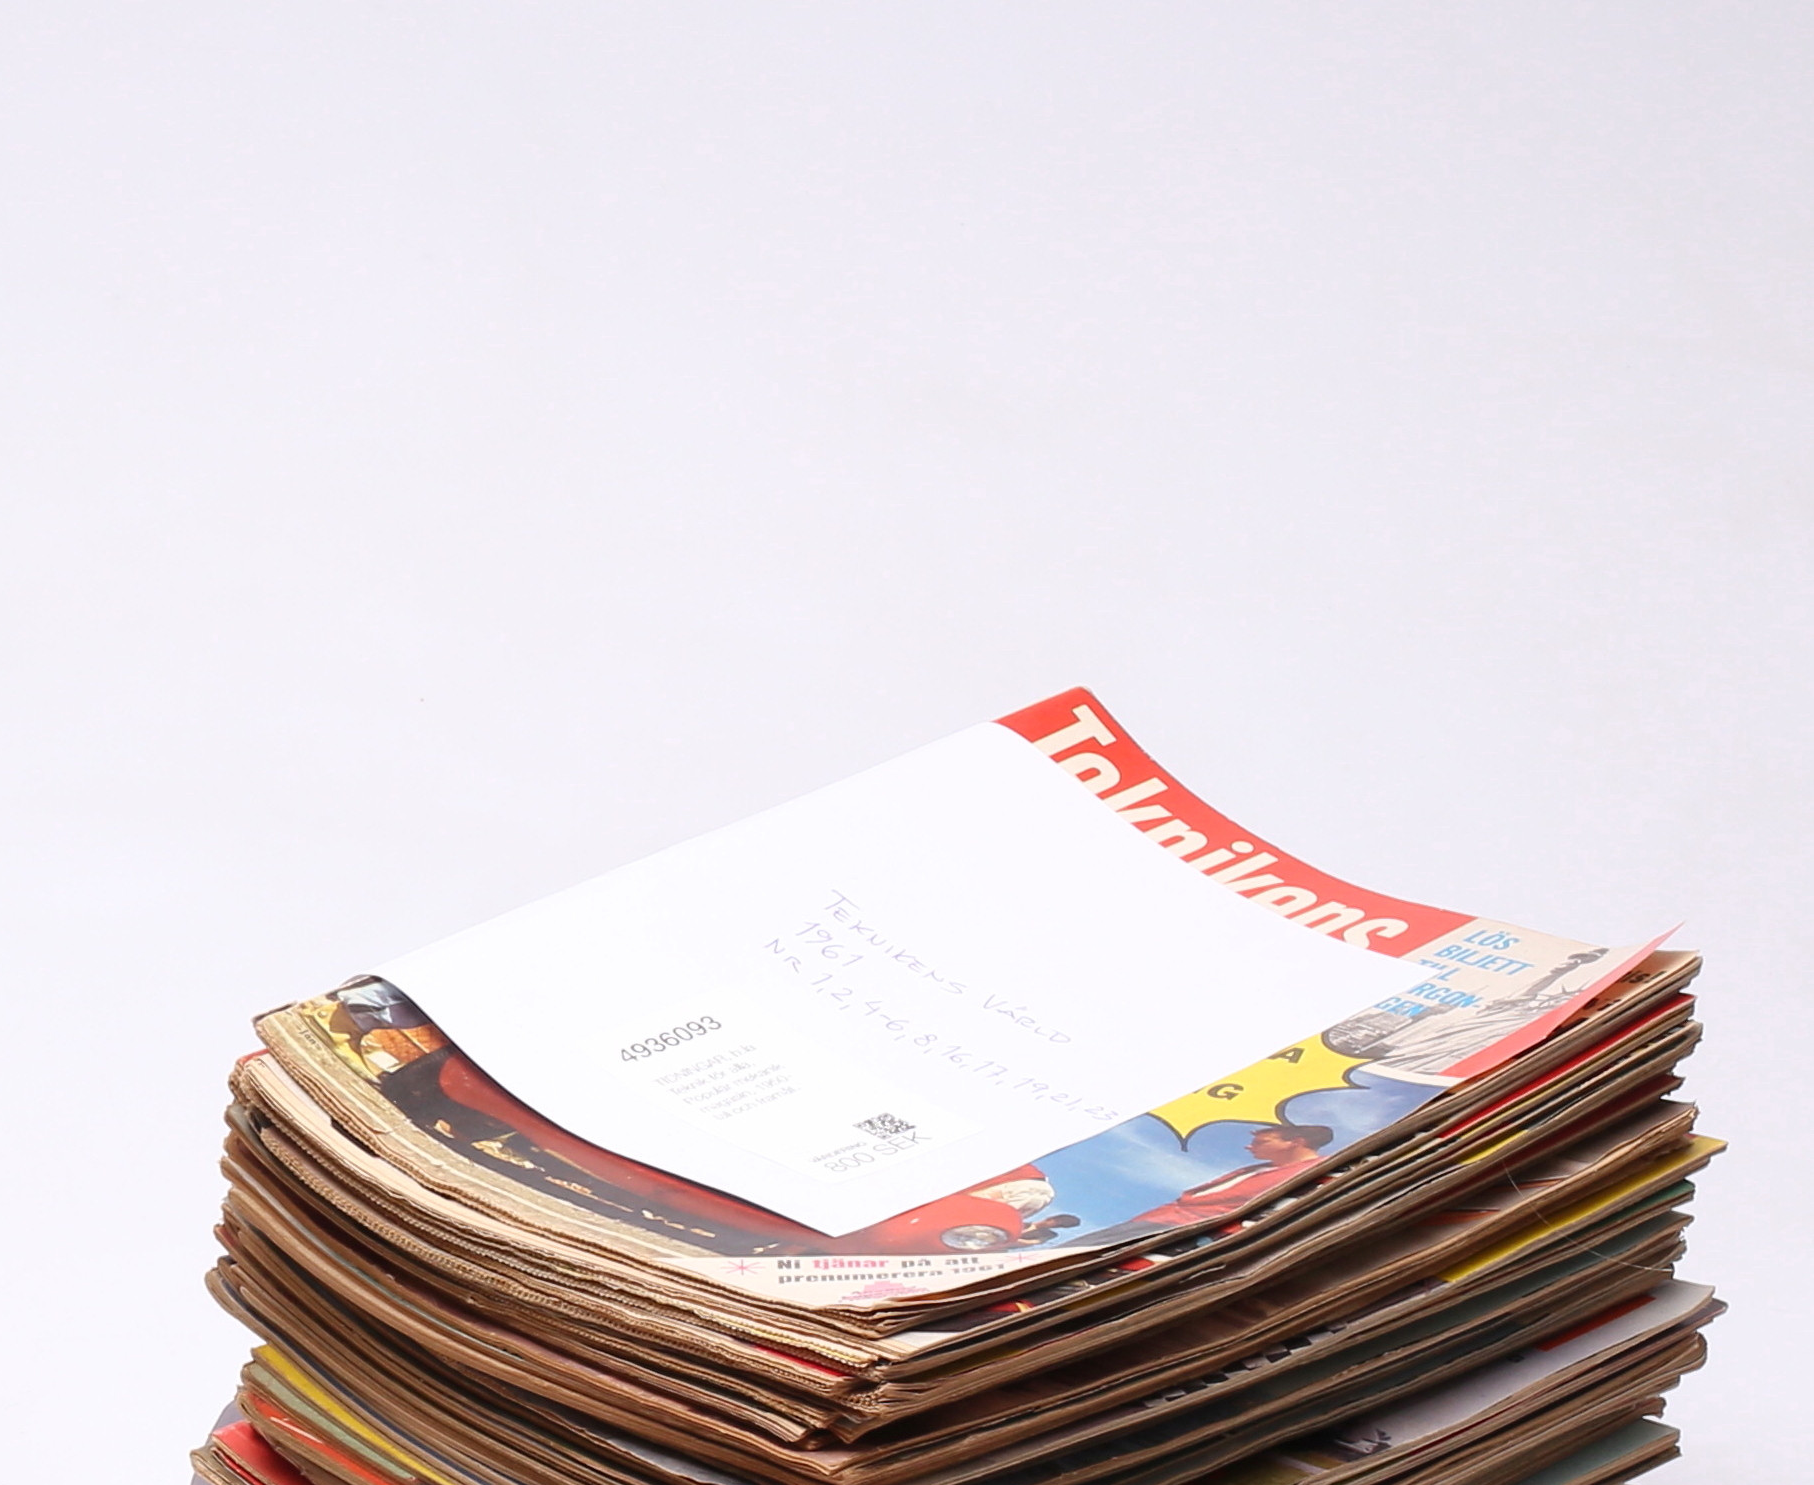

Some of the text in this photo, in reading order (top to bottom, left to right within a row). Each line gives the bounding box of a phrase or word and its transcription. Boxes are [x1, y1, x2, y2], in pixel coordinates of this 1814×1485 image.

[795, 921, 864, 966] 1961
[824, 889, 968, 995] TEKNIKENS
[1463, 930, 1522, 951] LÖS
[1433, 944, 1536, 976] BILJETT
[620, 1016, 722, 1064] 4936093
[824, 1151, 876, 1174] 800
[872, 1131, 933, 1155] SEK
[777, 1256, 980, 1273] Ni tjänar på att
[778, 1269, 943, 1284] prenumerera
